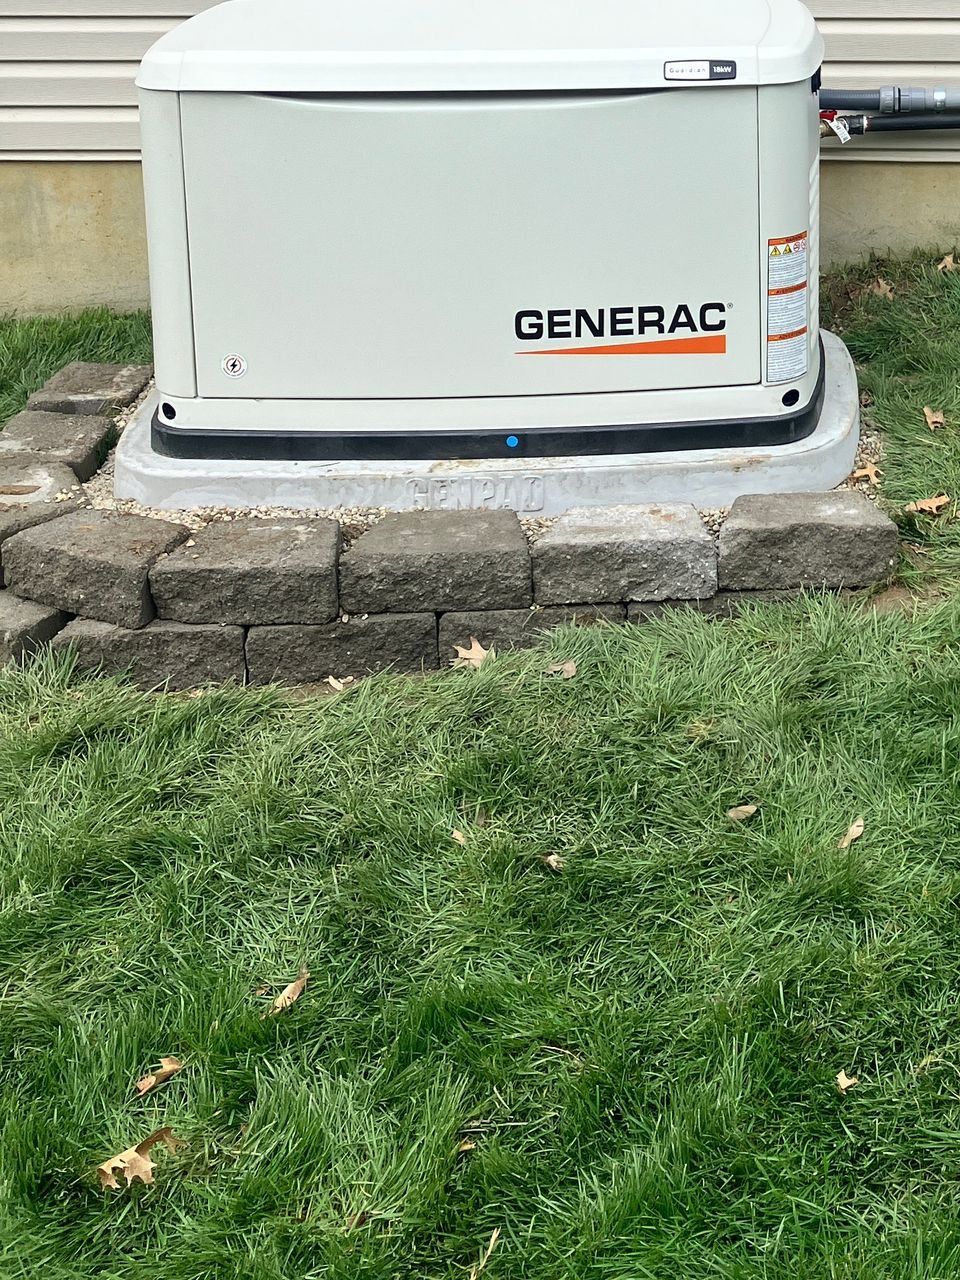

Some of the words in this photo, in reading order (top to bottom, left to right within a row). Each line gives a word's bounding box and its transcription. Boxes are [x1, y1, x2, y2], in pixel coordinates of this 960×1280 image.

[713, 65, 732, 73] 18kW
[514, 302, 727, 341] GENERAC
[405, 475, 545, 513] GENPAD
